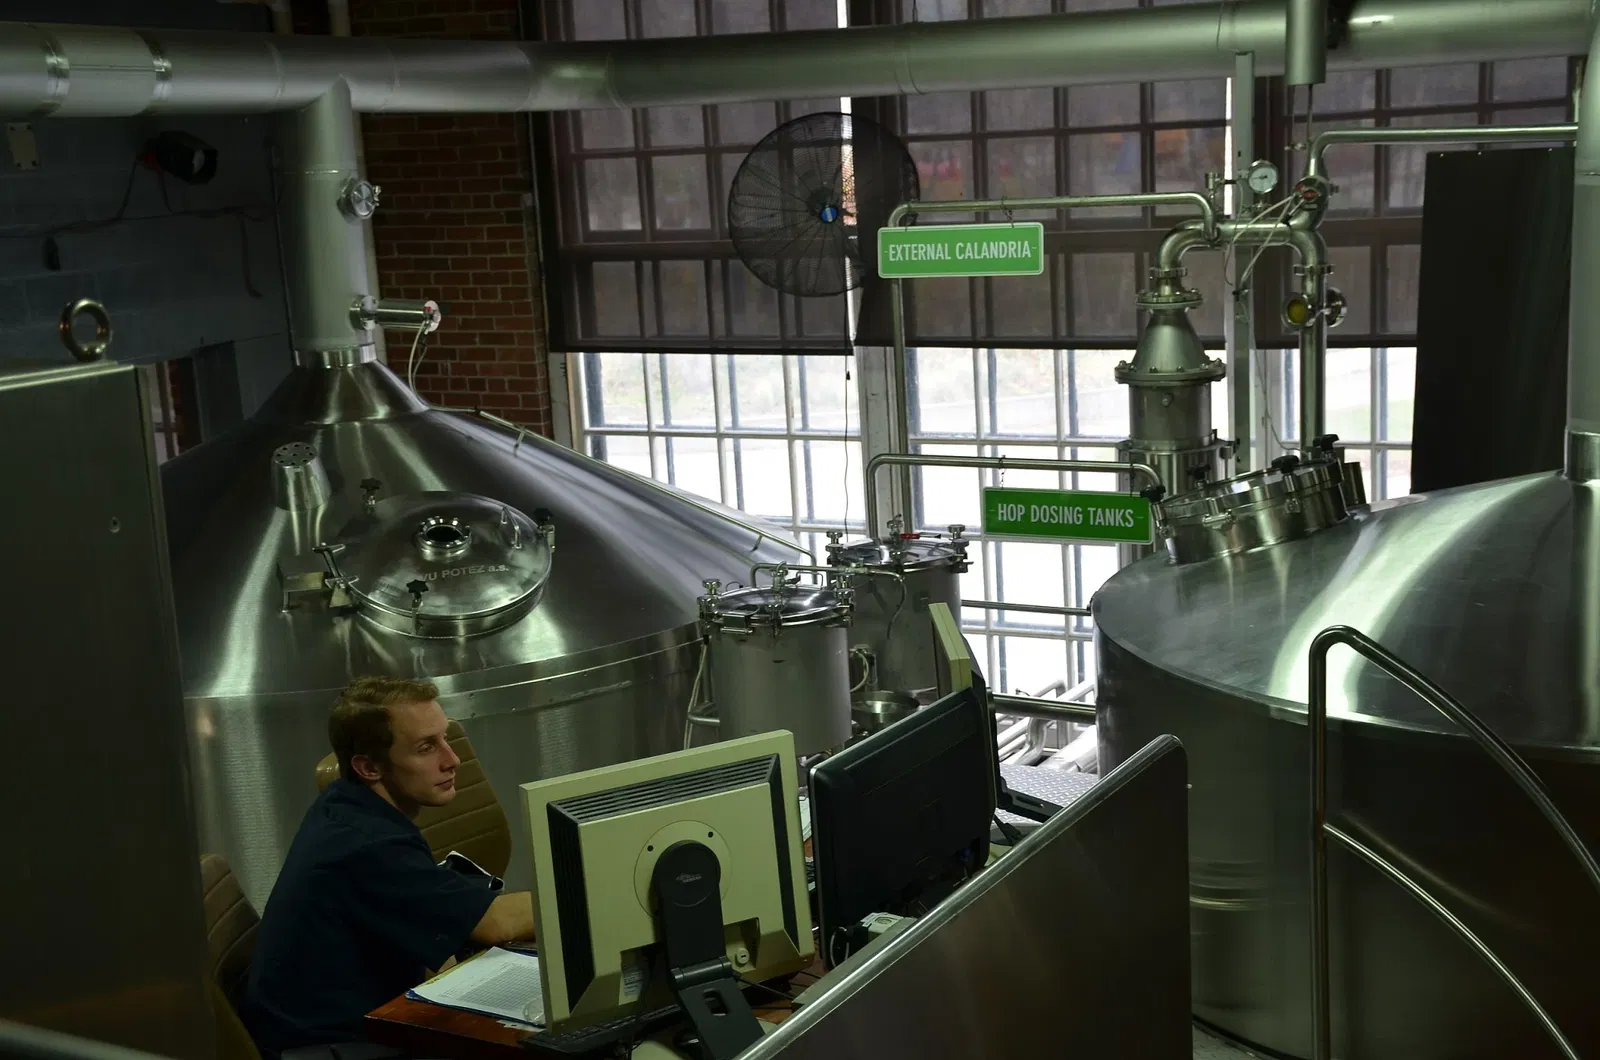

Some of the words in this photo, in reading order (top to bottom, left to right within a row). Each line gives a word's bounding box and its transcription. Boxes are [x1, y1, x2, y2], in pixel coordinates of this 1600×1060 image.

[889, 243, 952, 261] EXTERNAL
[956, 241, 1031, 260] CALANDRIA
[998, 503, 1025, 522] HOP
[1031, 505, 1083, 525] DOSING
[1088, 507, 1134, 528] TANKS
[443, 565, 485, 578] POTEZ
